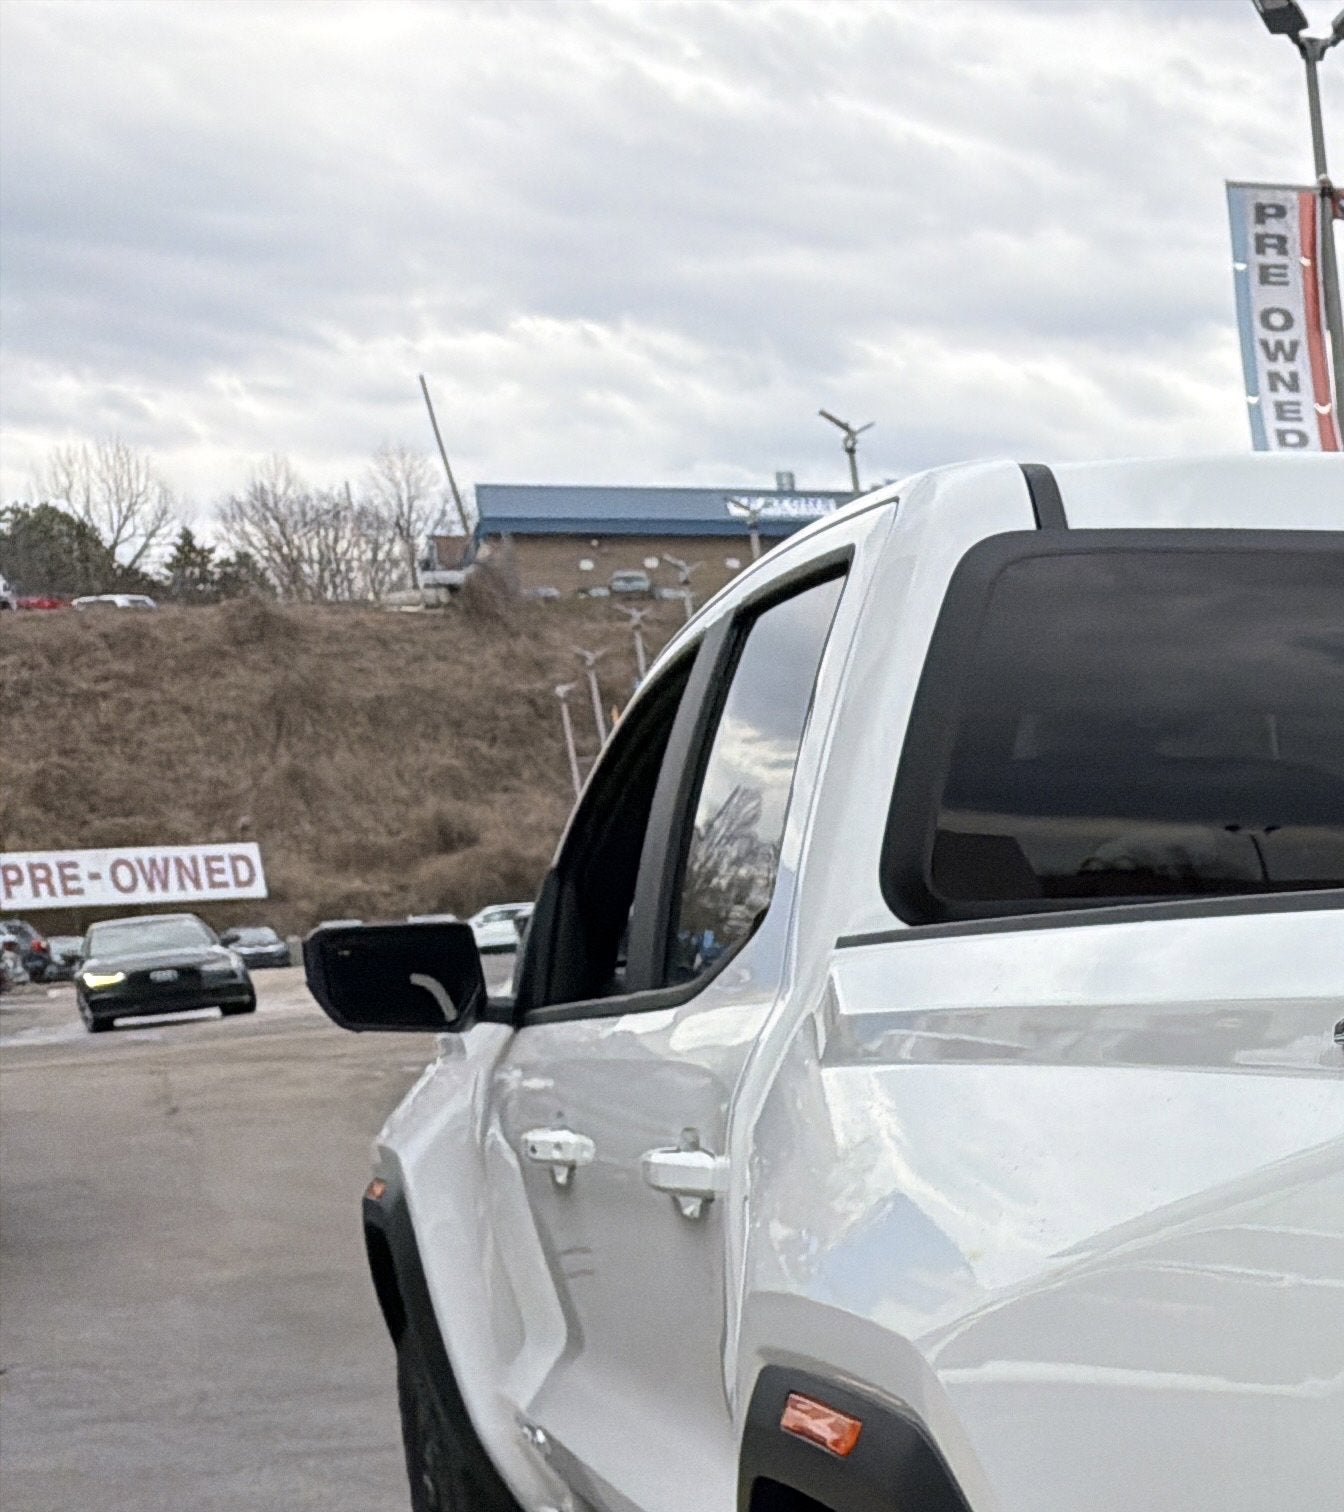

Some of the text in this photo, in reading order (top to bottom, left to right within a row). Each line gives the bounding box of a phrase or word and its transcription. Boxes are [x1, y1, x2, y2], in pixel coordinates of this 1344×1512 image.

[1254, 203, 1309, 448] PRE OWNED
[1, 854, 256, 899] PRE-OWNED
